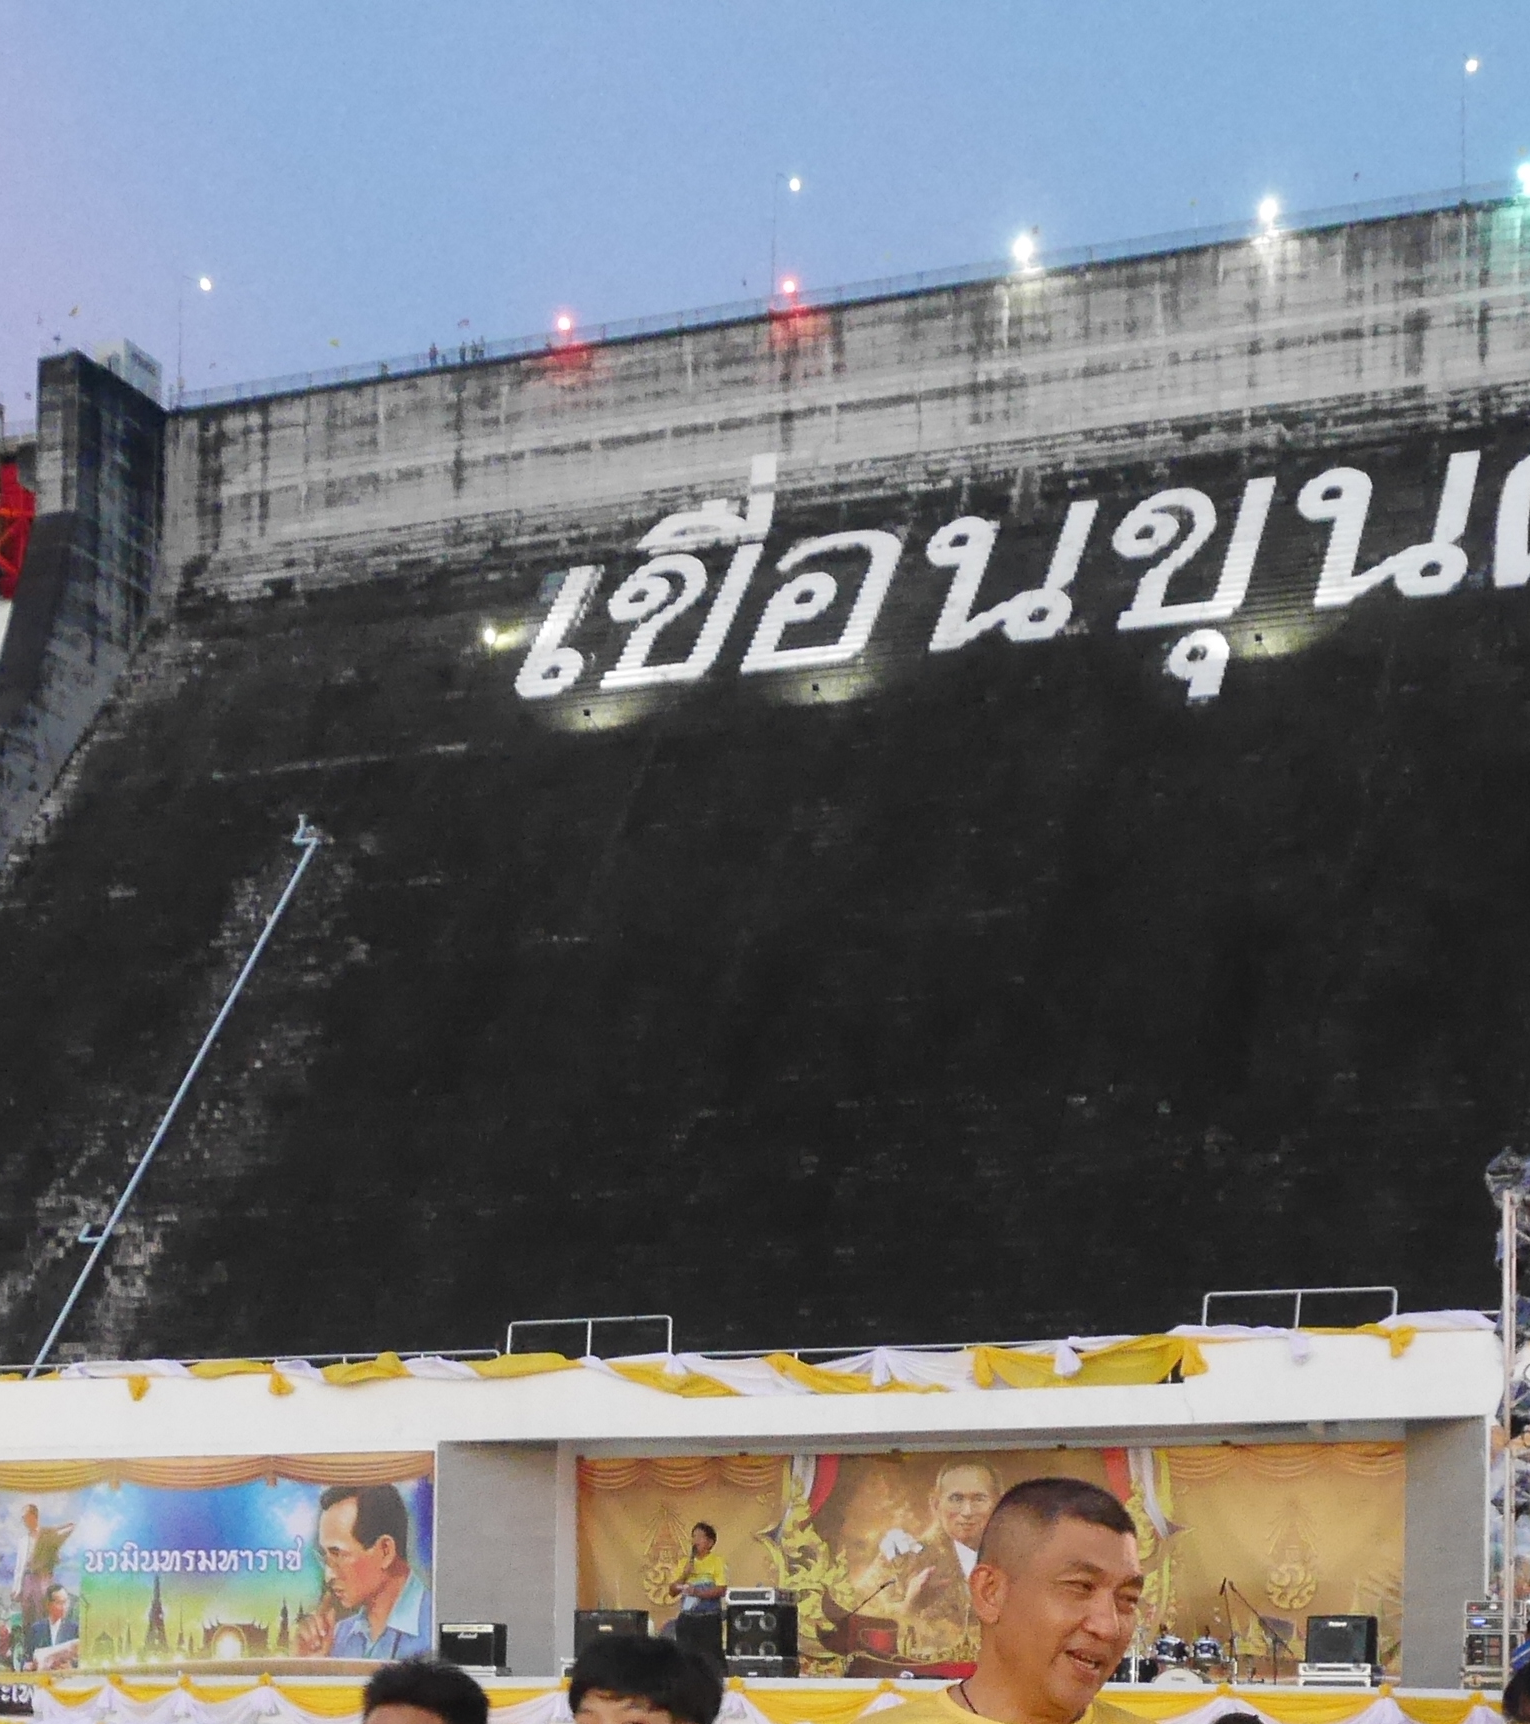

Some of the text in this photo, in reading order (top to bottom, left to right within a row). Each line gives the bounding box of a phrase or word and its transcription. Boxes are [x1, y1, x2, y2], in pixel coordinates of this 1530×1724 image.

[84, 1536, 303, 1573] นวมินทรมหาราช
